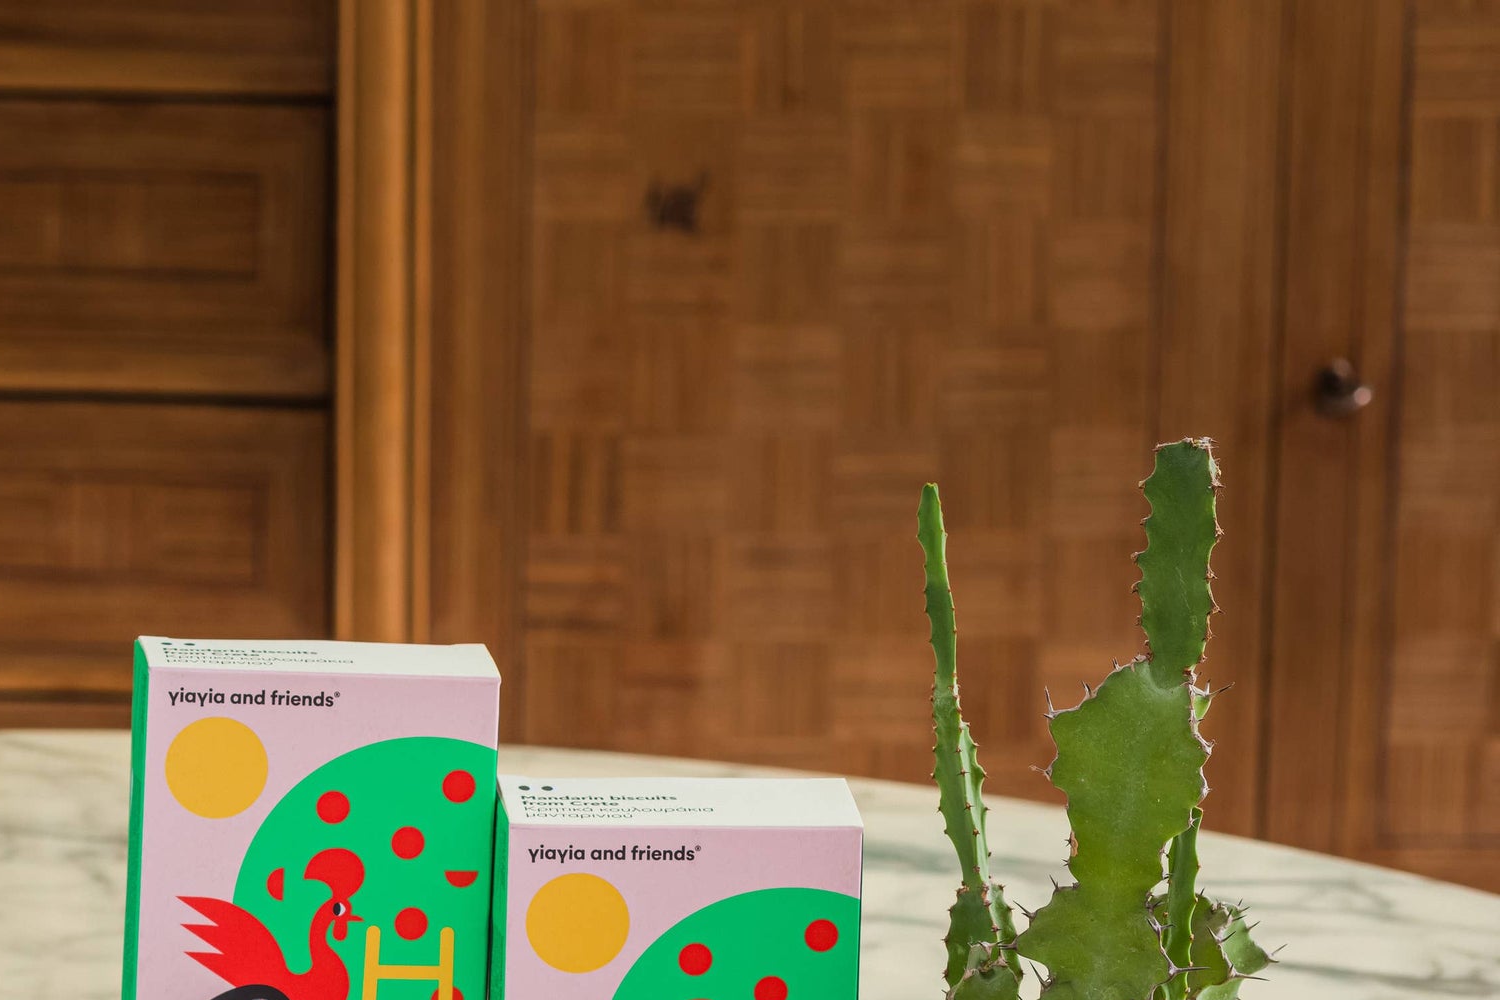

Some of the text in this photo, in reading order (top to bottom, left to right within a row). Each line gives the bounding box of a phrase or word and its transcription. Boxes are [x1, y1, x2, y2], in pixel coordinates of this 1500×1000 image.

[168, 687, 225, 707] yiayia
[230, 689, 266, 705] and
[528, 844, 586, 864] yiayia
[590, 845, 626, 861] and
